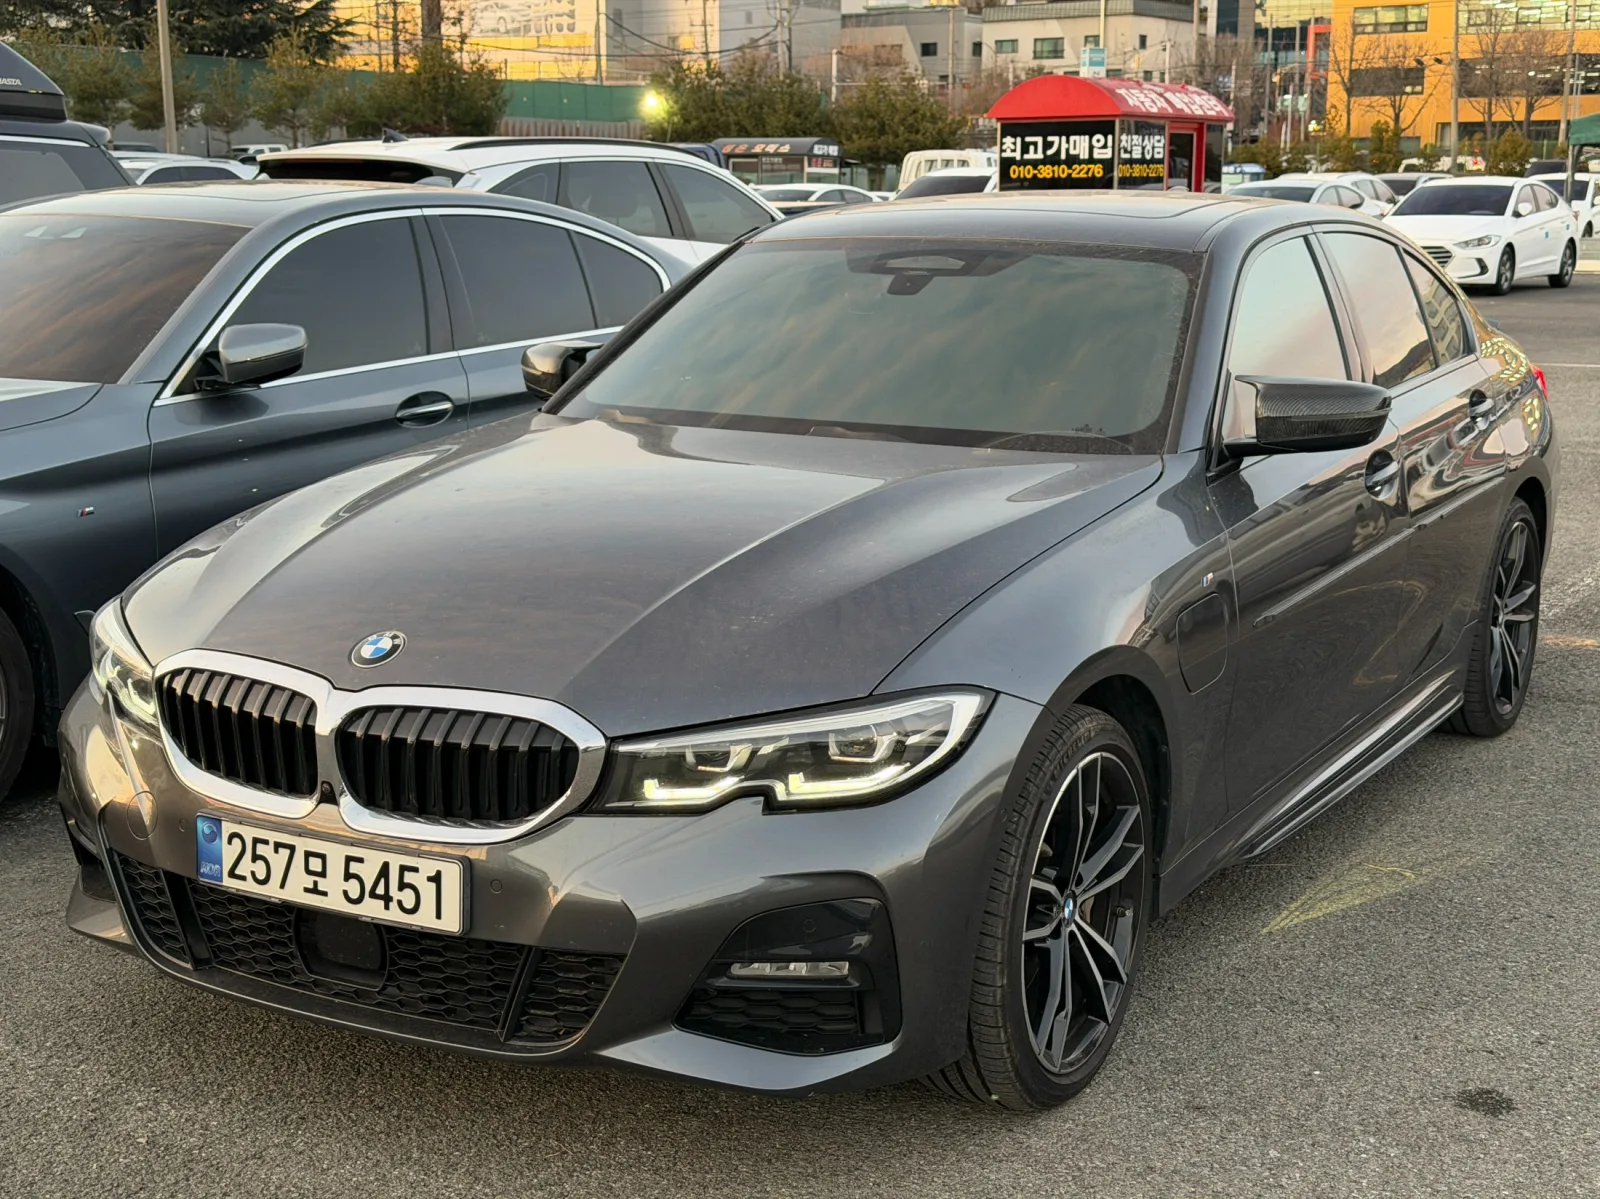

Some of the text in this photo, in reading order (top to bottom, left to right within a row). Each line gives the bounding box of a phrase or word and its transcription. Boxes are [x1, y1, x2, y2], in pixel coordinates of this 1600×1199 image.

[1115, 87, 1173, 114] 자동차
[1001, 133, 1113, 160] 최고가매입
[1119, 133, 1165, 160] 친절상담
[1009, 164, 1103, 179] 010-3810-2276
[1118, 163, 1164, 177] 010-3810-2276
[200, 861, 221, 877] KOR
[226, 831, 443, 920] 257모 5451
